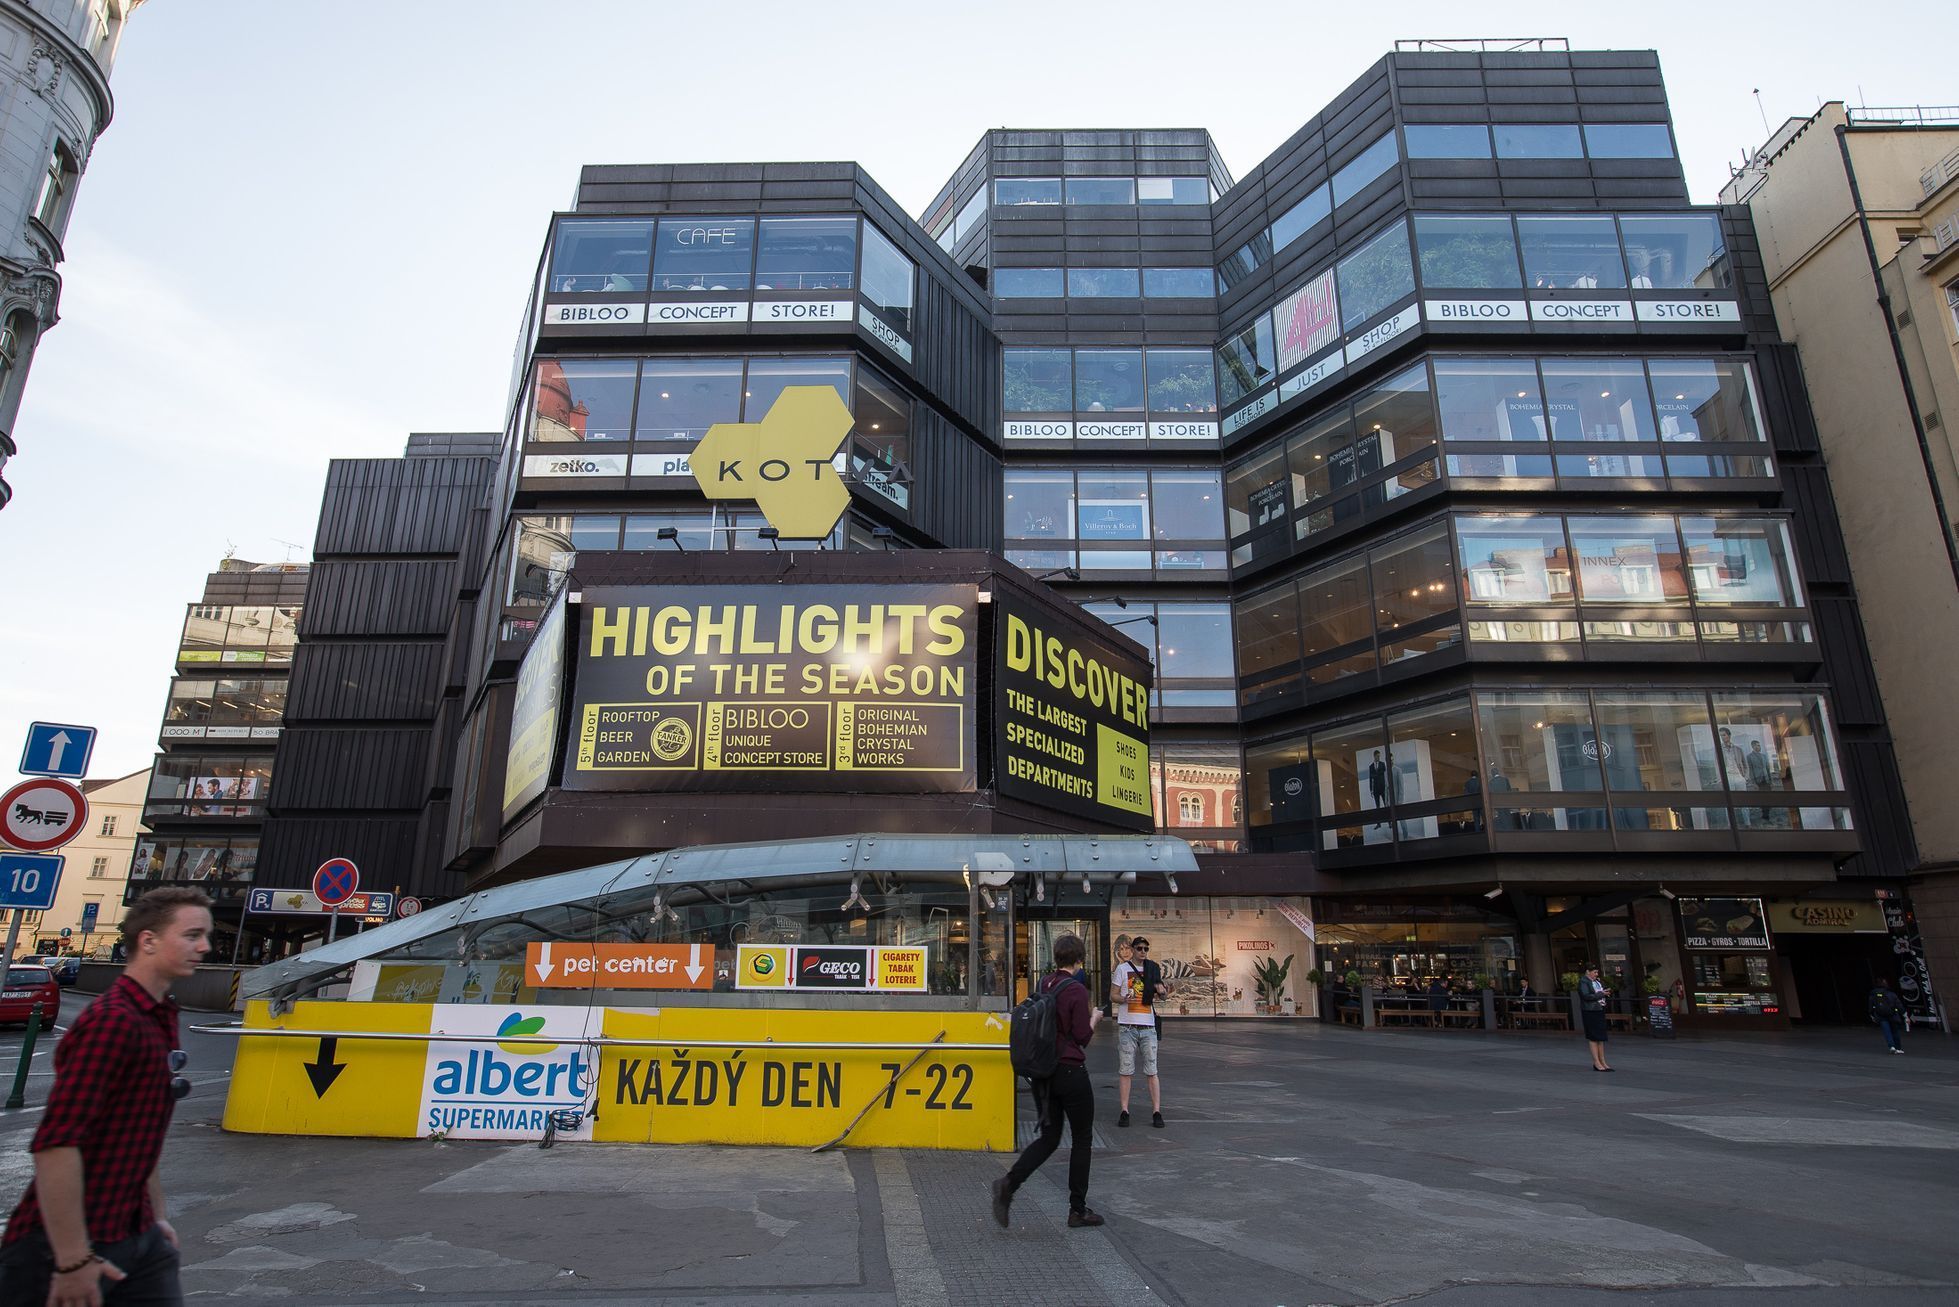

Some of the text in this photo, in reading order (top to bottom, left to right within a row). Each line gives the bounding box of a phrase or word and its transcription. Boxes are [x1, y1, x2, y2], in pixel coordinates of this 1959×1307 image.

[676, 227, 736, 245] CAFE
[560, 304, 834, 320] BIBLOO CONCEPT STORE!
[1441, 304, 1721, 318] BIBLOO CONCEPT STORE!
[872, 317, 900, 345] SHOP
[1362, 316, 1400, 348] SHOP
[1296, 363, 1326, 390] JUST
[1233, 398, 1265, 424] LIFE IS
[1010, 424, 1211, 436] BIBLOO CONCEPT STORE!
[663, 458, 694, 475] pla
[1084, 522, 1112, 532] Villeroy
[1119, 522, 1137, 530] Boch
[1583, 556, 1626, 568] INNEX
[590, 604, 965, 657] HIGHLIGHTS
[646, 663, 964, 697] OF THE SEASON
[1007, 614, 1148, 731] DISCOVER
[602, 711, 660, 723] ROOFTOP
[726, 708, 809, 729] BIBLOO
[858, 710, 920, 721] ORIGINAL
[1007, 688, 1087, 737] THE LARGEST
[580, 711, 596, 763] 5th floor
[600, 732, 633, 742] BEER
[706, 708, 721, 763] 4th floor
[838, 708, 852, 763] 3rd floor
[858, 724, 928, 736] BOHEMIAN
[726, 735, 772, 747] UNIQUE
[857, 738, 915, 750] CRYSTAL
[1006, 722, 1084, 766] SPECIALIZED
[597, 751, 650, 763] GARDEN
[724, 752, 823, 764] CONCEPT STORE
[856, 752, 905, 764] WORKS
[1116, 741, 1137, 760] SHOES
[1008, 756, 1092, 798] DEPARTMENTS
[1120, 764, 1135, 781] KIDS
[1112, 785, 1142, 806] LINGERIE
[12, 868, 40, 893] 10
[1792, 906, 1857, 920] CASINO
[1806, 918, 1849, 926] ADMIRAL
[1238, 942, 1268, 950] PIKOLINOS
[1688, 937, 1766, 946] PIZZA GYROS TORTILLA
[564, 955, 678, 976] pet center
[882, 952, 920, 962] CIGARETY
[820, 962, 861, 974] GECO
[888, 963, 914, 973] TABÁK
[885, 975, 917, 984] LOTERIE
[433, 1050, 588, 1098] albert
[616, 1049, 747, 1107] KAŽDÝ
[762, 1062, 842, 1108] DEN
[428, 1108, 584, 1130] SUPERMARKT
